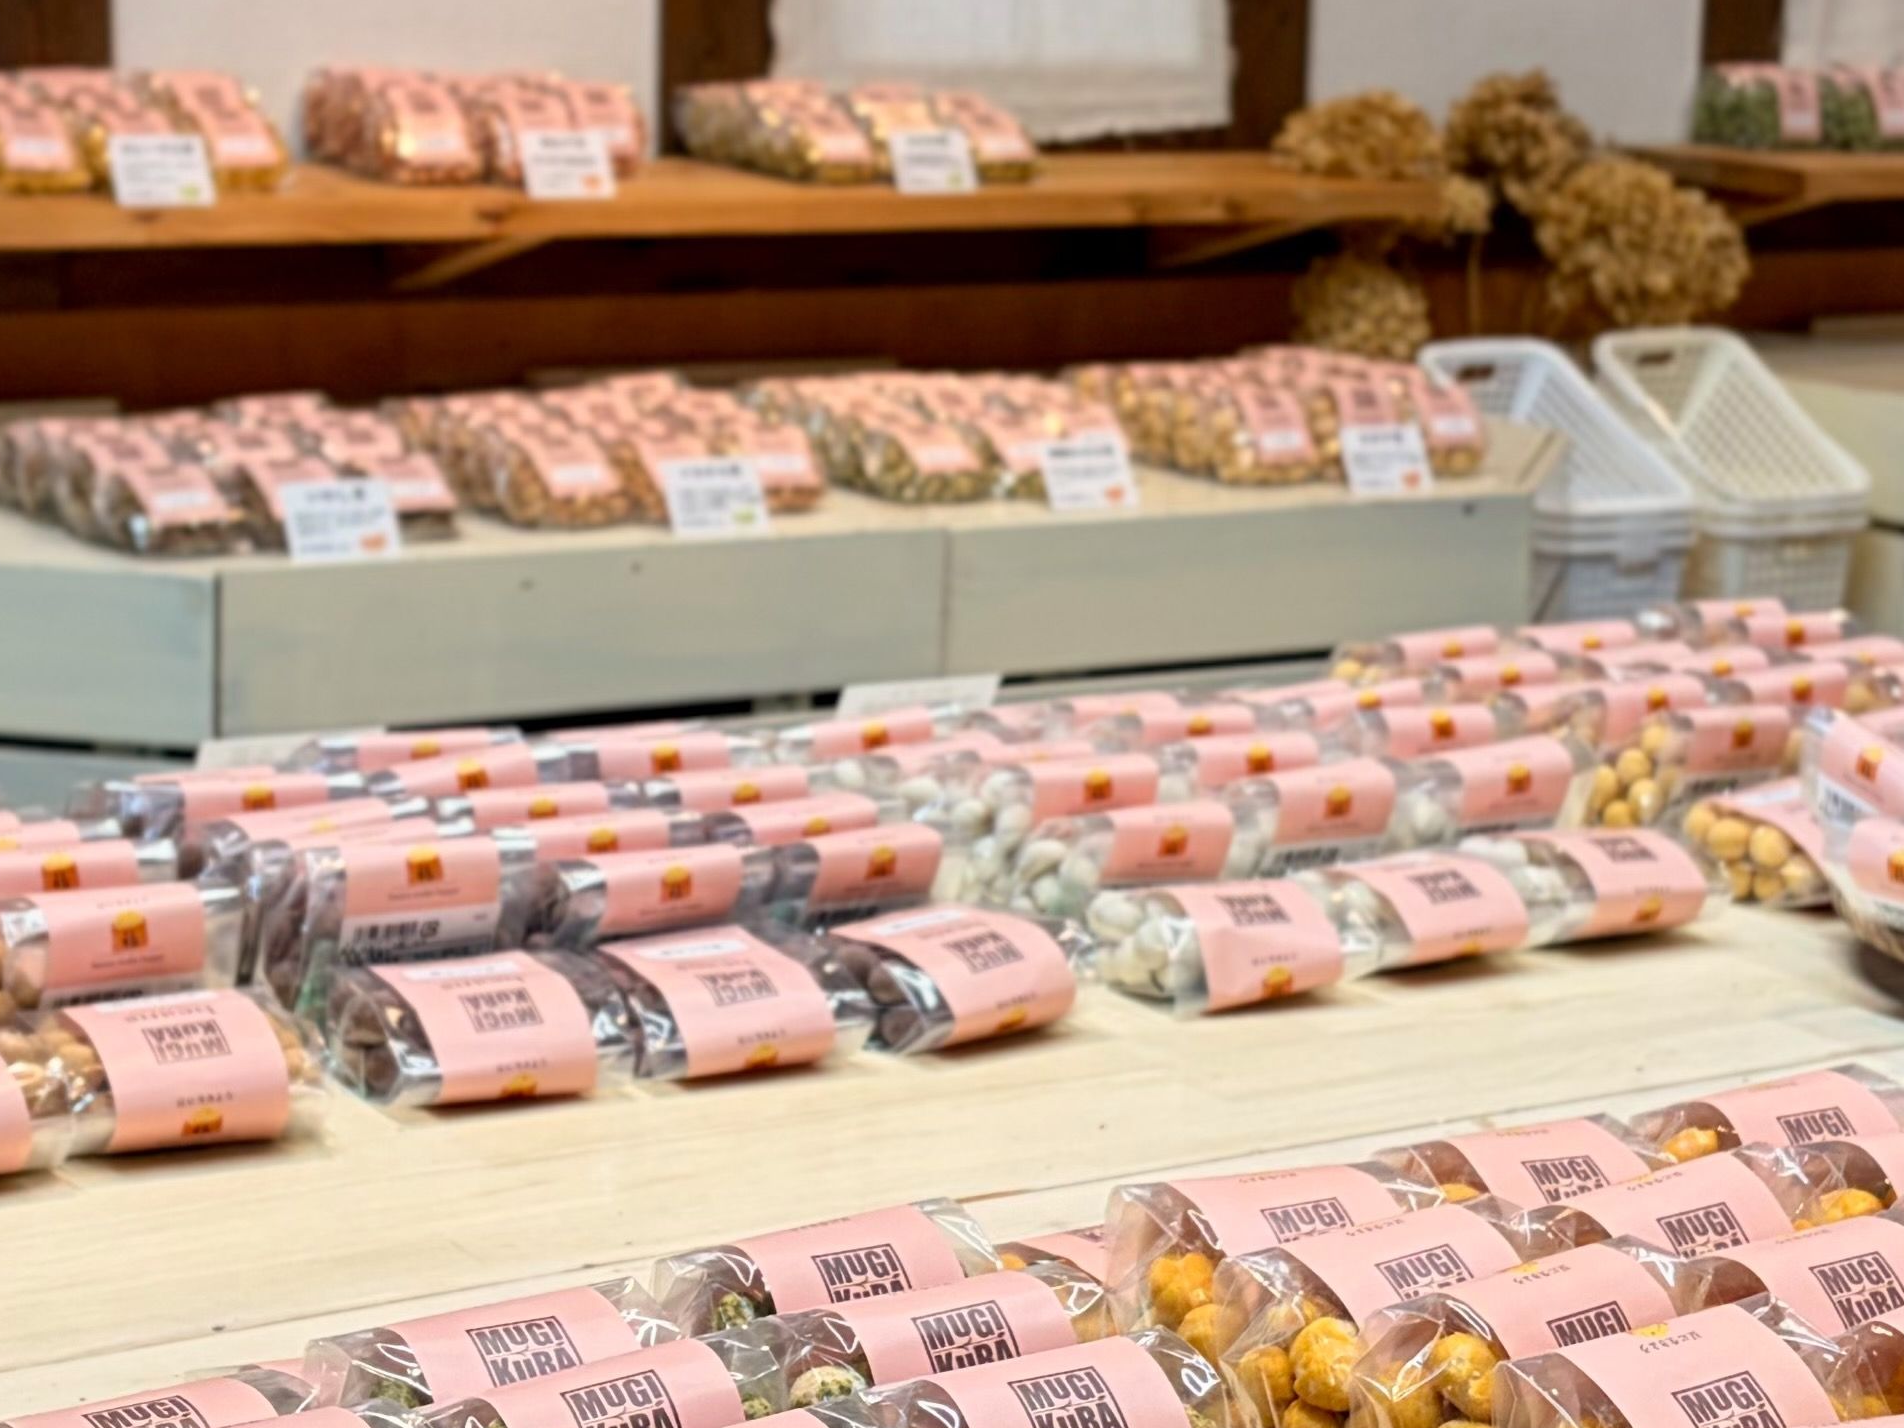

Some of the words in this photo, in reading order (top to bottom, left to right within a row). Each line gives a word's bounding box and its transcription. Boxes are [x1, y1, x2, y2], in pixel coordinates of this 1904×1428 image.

[1383, 1247, 1463, 1286] MUGI
[570, 1373, 664, 1422] MUGI
[1680, 1374, 1764, 1421] MUGI
